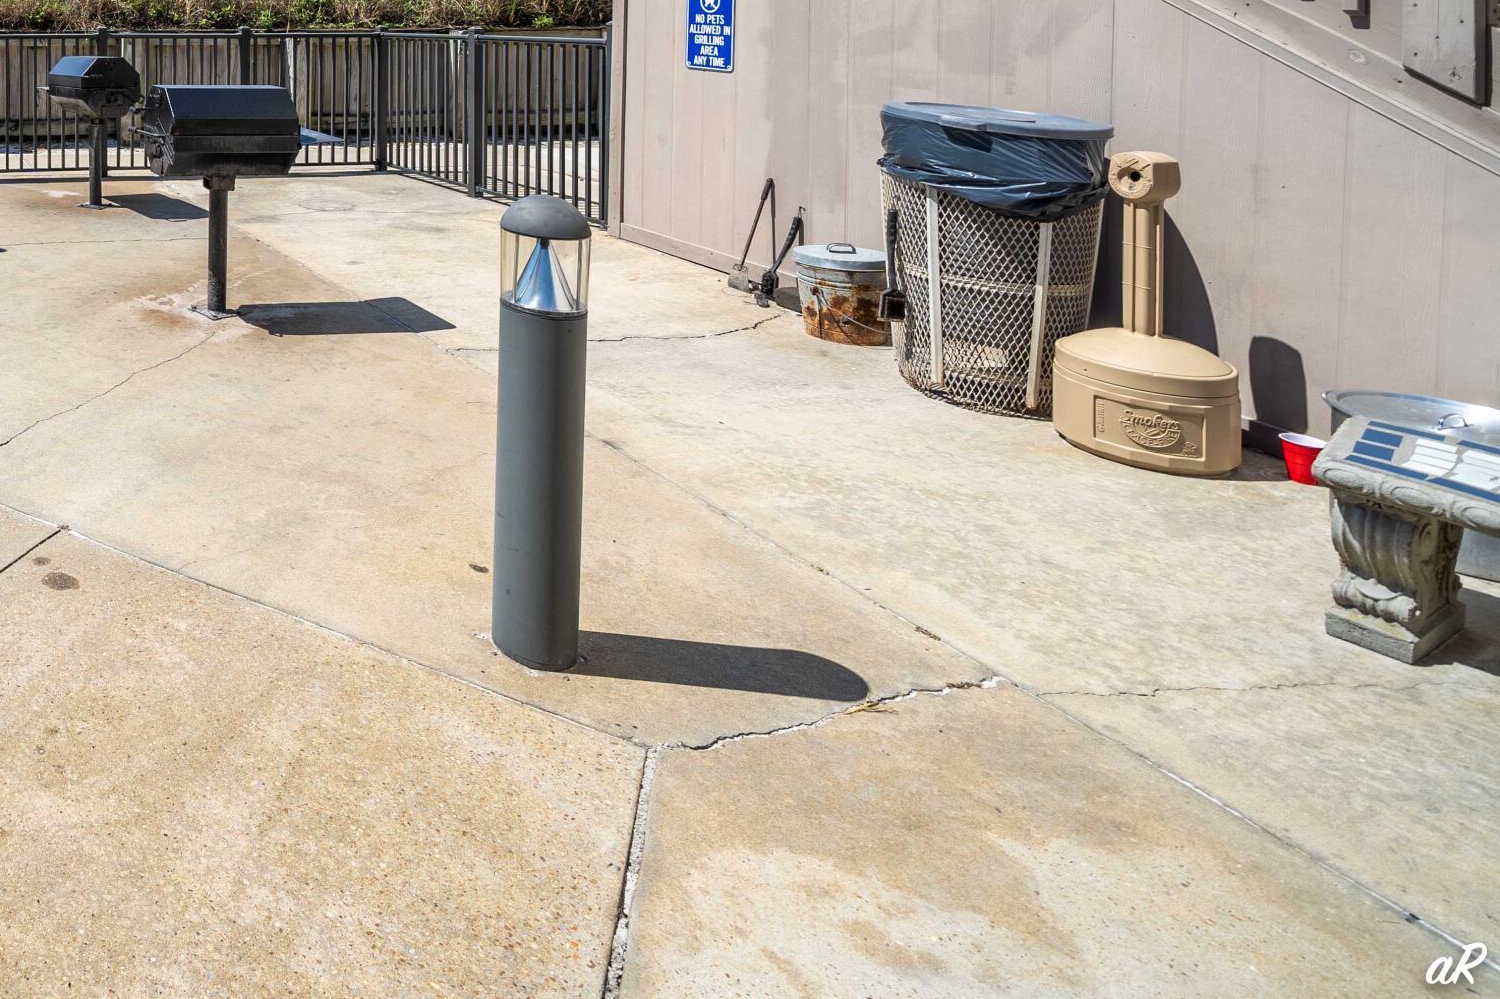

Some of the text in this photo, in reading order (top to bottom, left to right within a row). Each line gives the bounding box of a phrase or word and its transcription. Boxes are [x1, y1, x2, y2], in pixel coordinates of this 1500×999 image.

[696, 14, 724, 24] NO PETS
[690, 24, 730, 35] ALLOWED IN
[695, 35, 724, 45] GRILLING
[700, 46, 718, 56] AREA
[694, 56, 725, 67] ANY TIME
[1118, 409, 1180, 430] Smokers
